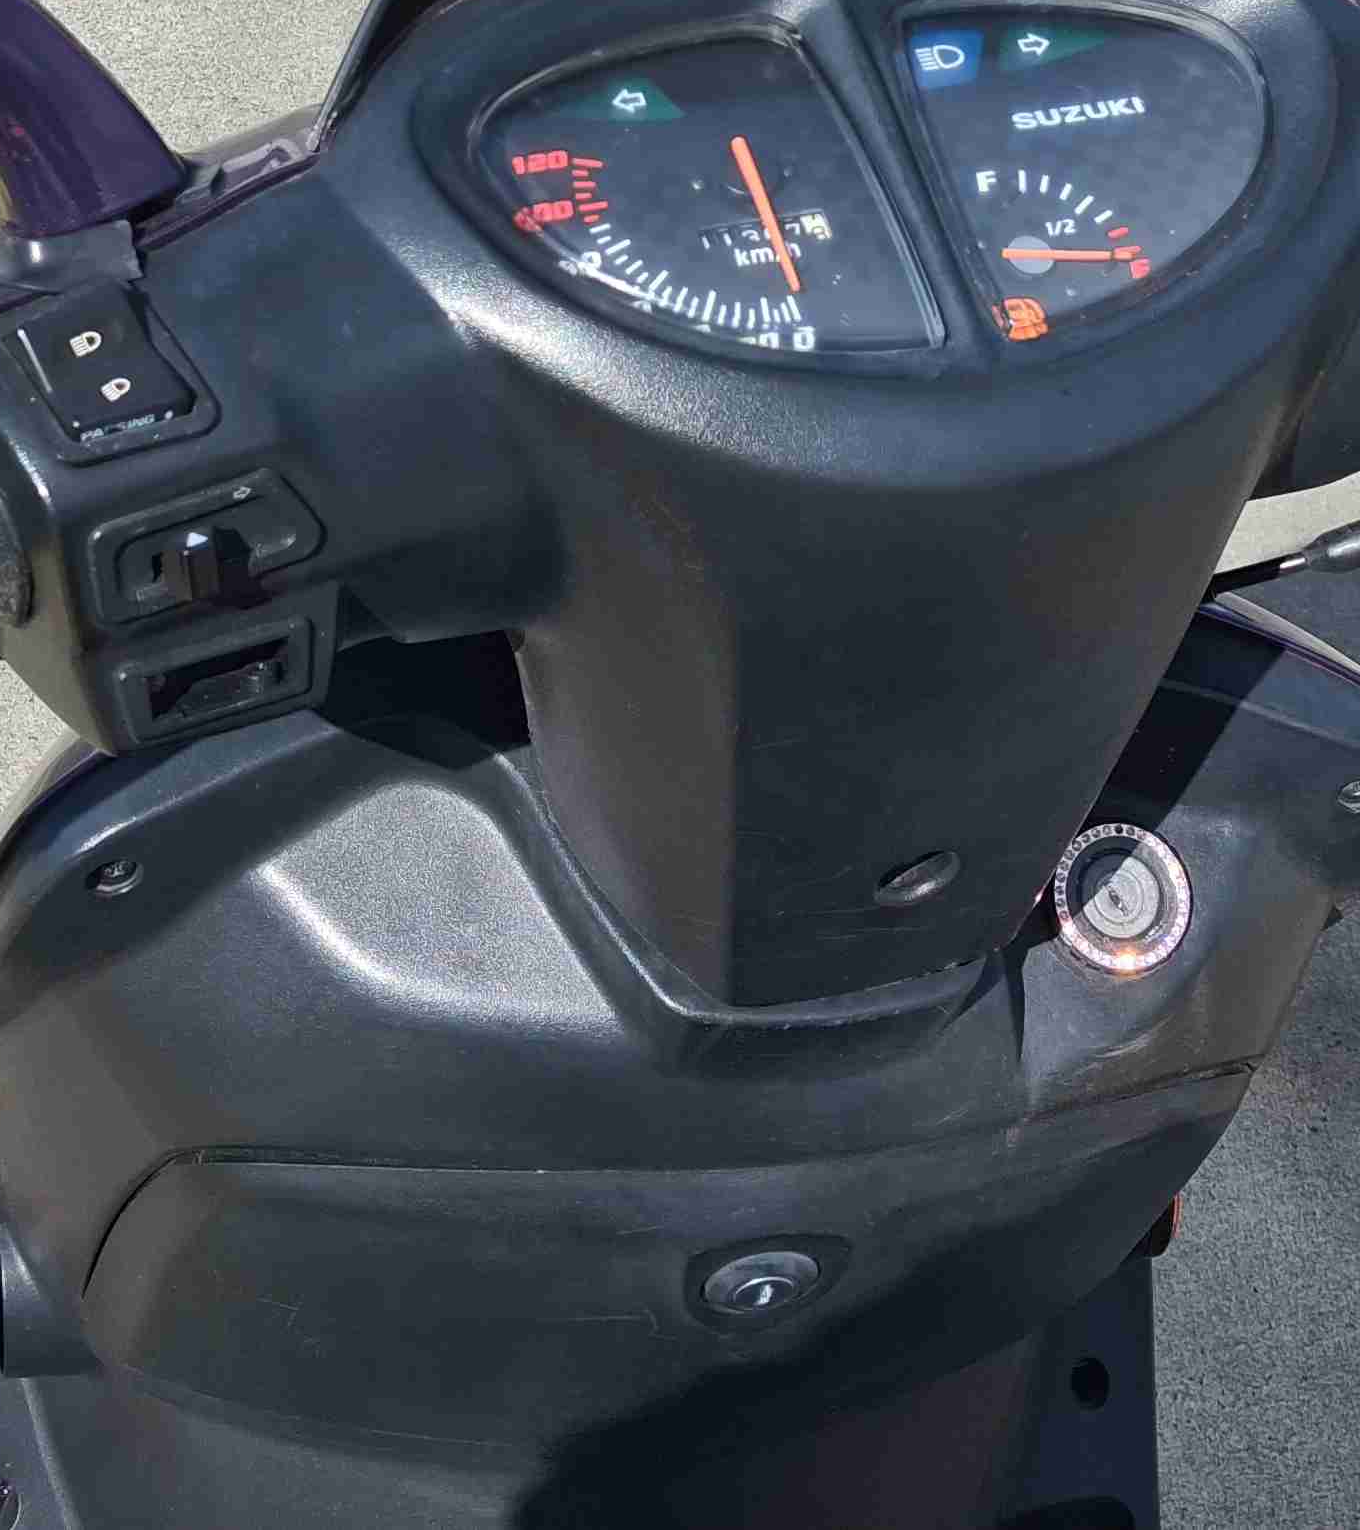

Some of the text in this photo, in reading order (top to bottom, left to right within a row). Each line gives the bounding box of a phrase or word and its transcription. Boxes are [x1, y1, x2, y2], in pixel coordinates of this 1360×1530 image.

[1012, 97, 1145, 129] SUZUKI
[512, 150, 568, 174] 120
[976, 171, 997, 192] F
[1045, 219, 1076, 237] 1/2
